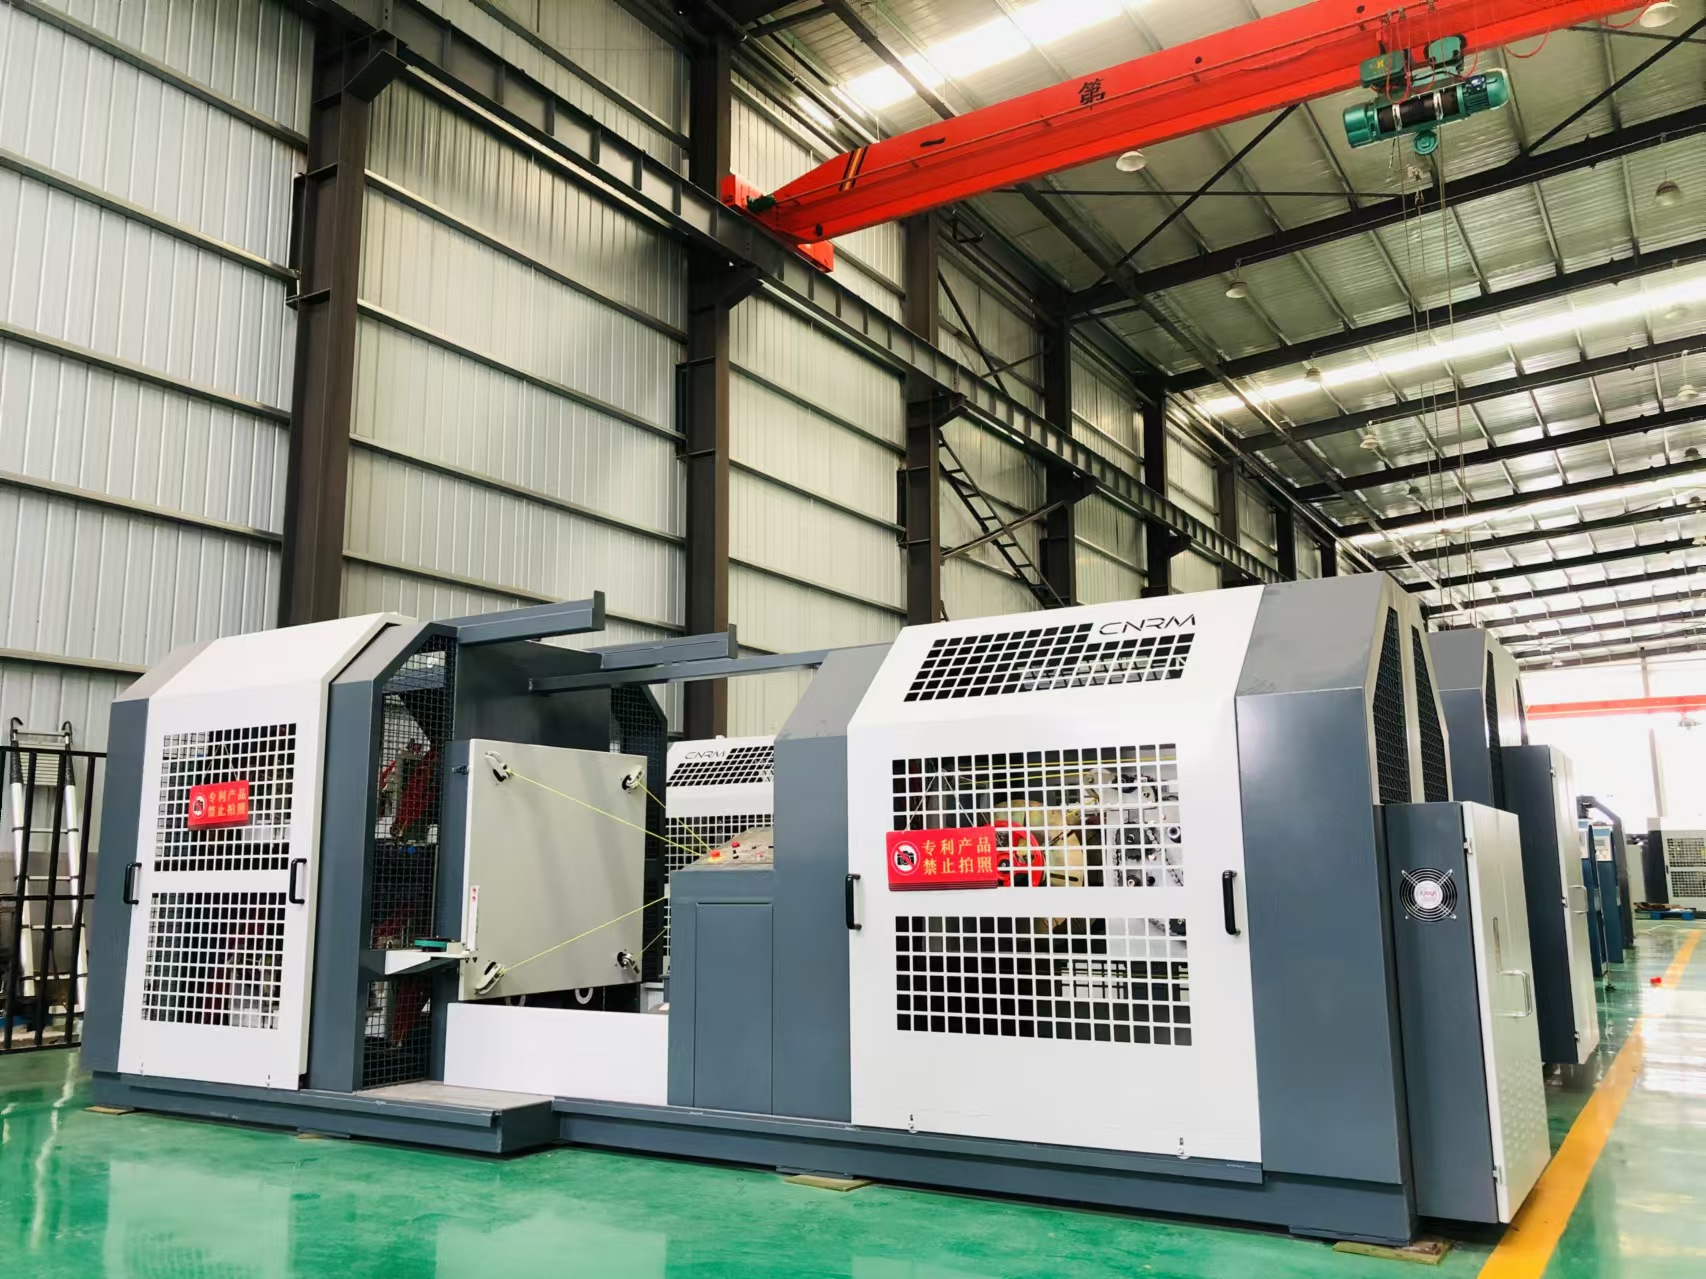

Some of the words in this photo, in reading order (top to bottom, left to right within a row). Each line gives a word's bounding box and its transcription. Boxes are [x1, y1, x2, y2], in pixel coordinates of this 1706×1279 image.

[1077, 77, 1107, 110] 第
[1099, 613, 1195, 635] CNRM
[684, 750, 726, 760] CNRM
[920, 836, 992, 856] 专利产品
[922, 856, 993, 875] 禁止拍照
